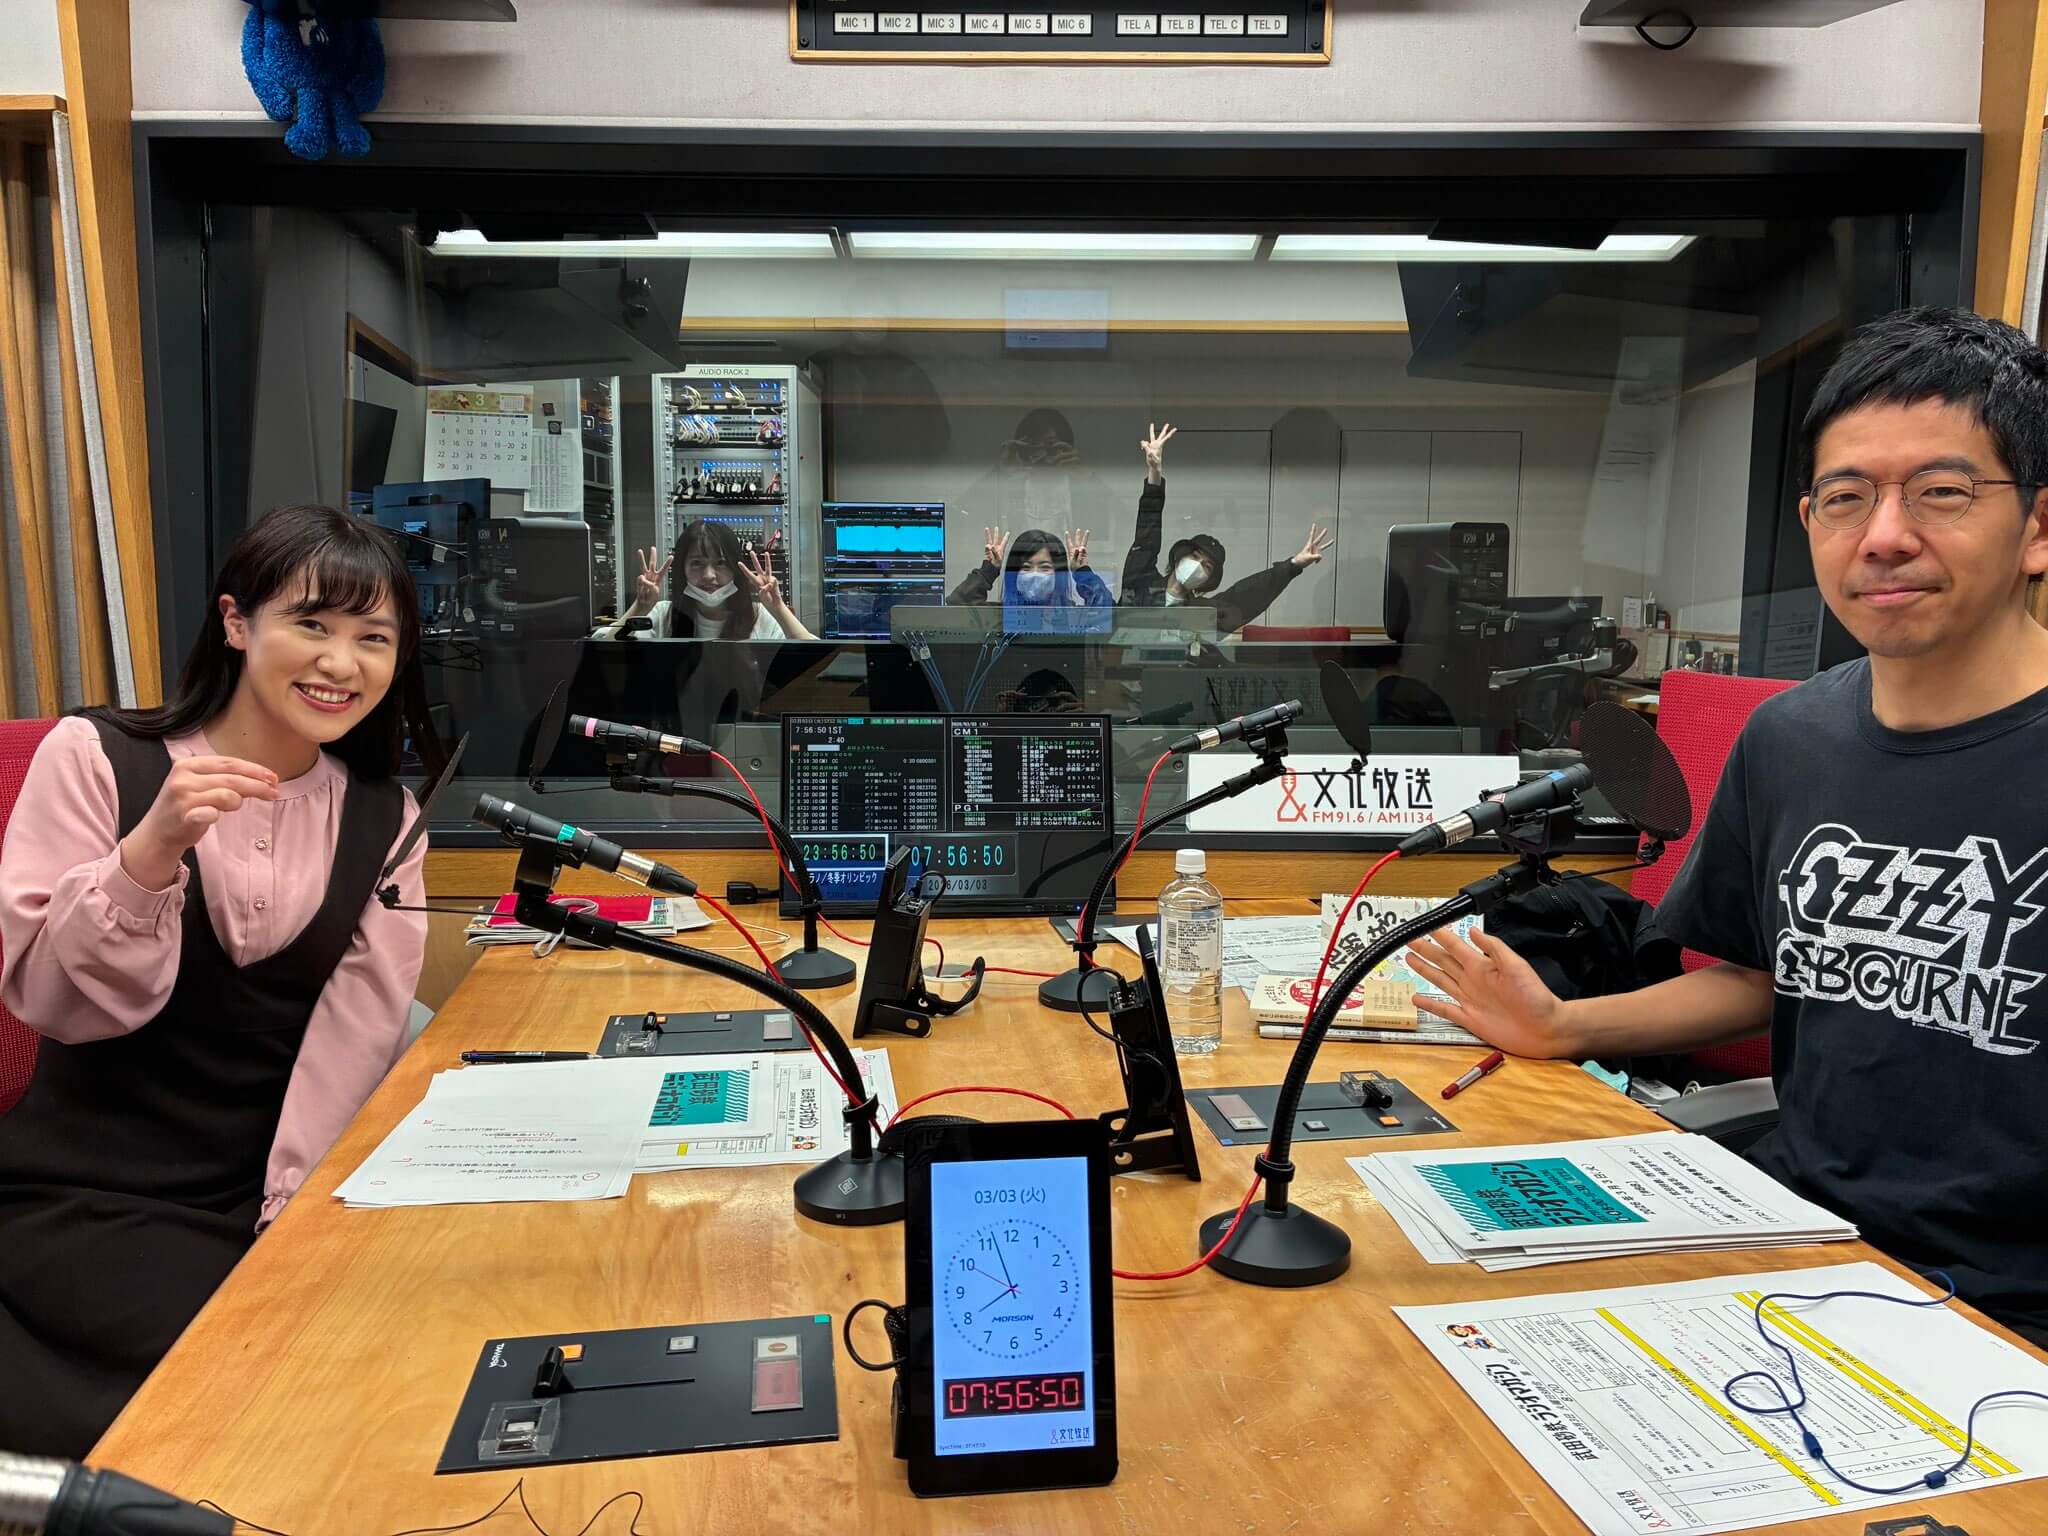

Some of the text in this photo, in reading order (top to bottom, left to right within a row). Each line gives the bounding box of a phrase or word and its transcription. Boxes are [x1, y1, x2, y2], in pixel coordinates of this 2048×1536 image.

[842, 17, 866, 27] MIC 1
[884, 18, 911, 27] MIC 2
[928, 18, 954, 28] MIC 3
[972, 19, 998, 28] MIC 4
[1015, 19, 1041, 28] MIC 5
[1058, 19, 1084, 29] MIC 6
[1124, 20, 1150, 29] TEL A
[1168, 20, 1193, 29] TEL B
[1211, 19, 1237, 29] TEL C
[1254, 20, 1280, 29] TEL D
[475, 394, 485, 406] 3
[795, 726, 843, 734] 7:56:50 1ST
[1312, 767, 1433, 809] 文化放送
[803, 844, 876, 861] 23:56:50
[911, 845, 1003, 867] 07:56:50
[809, 872, 877, 884] ラノ/冬季オリンピック
[928, 879, 988, 891] 206/03/03
[1778, 823, 2048, 973] OZZY
[974, 1189, 1017, 1204] 03/03
[1492, 1162, 1592, 1225] ラジオマガジン
[1004, 1229, 1020, 1242] 12
[979, 1238, 993, 1251] 11
[1033, 1236, 1039, 1248] 1
[960, 1258, 975, 1272] 10
[1052, 1254, 1061, 1267] 2
[1059, 1280, 1068, 1293] 3
[956, 1287, 965, 1299] 9
[964, 1312, 972, 1325] 8
[992, 1314, 1034, 1323] MORSON
[1053, 1307, 1062, 1319] 4
[984, 1331, 992, 1344] 7
[1034, 1328, 1043, 1341] 5
[1010, 1336, 1019, 1349] 6
[949, 1377, 1080, 1413] 07:56:50
[1059, 1427, 1090, 1442] 文化放送
